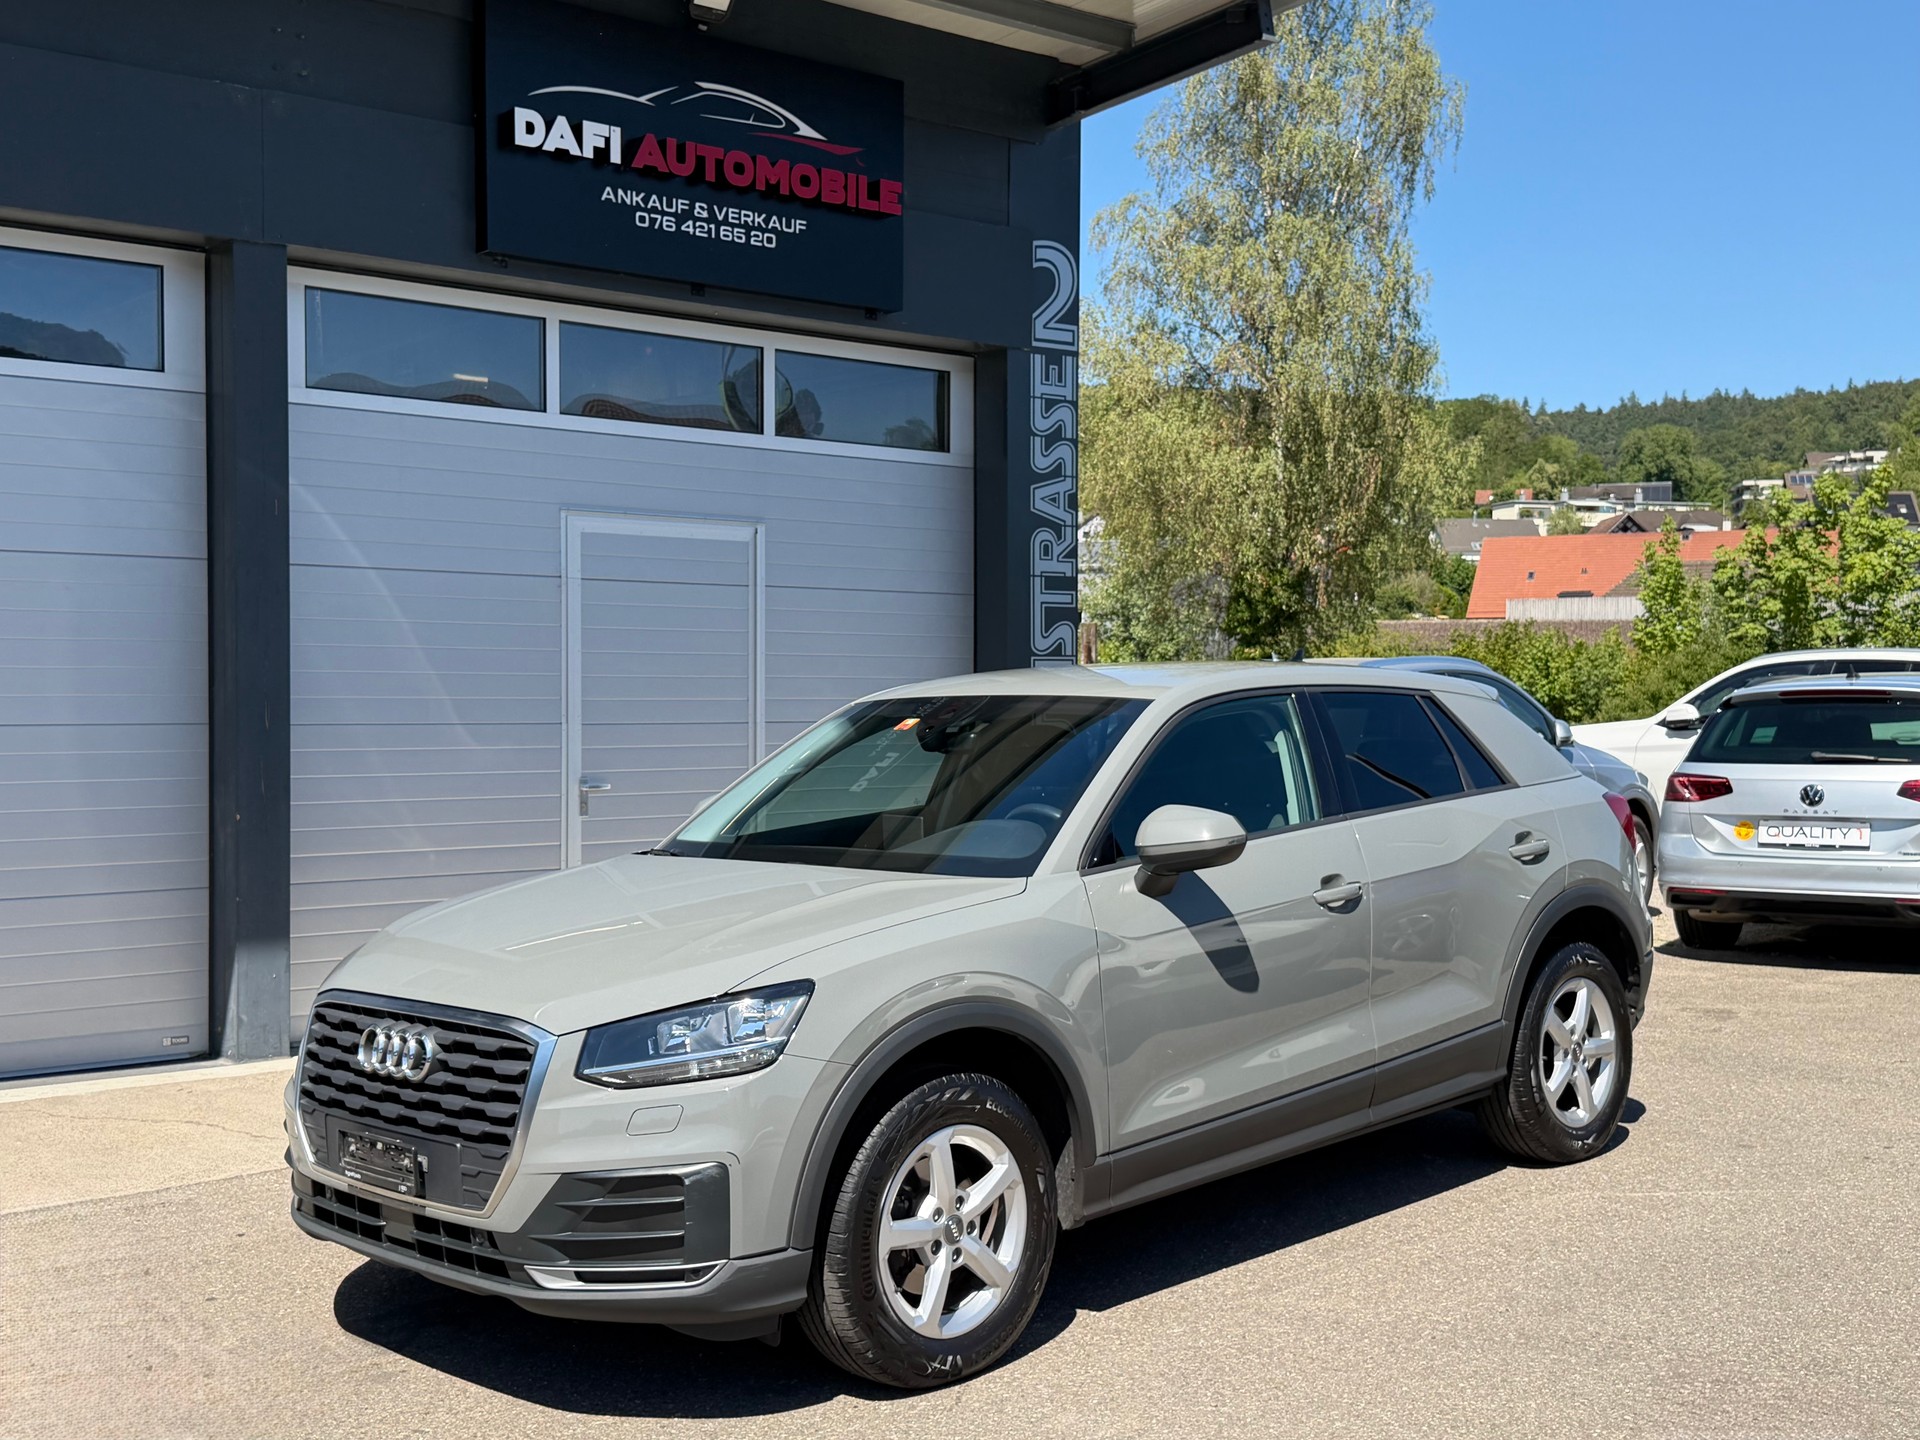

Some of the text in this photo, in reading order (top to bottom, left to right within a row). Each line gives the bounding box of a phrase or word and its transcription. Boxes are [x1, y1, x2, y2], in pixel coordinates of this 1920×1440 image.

[514, 106, 902, 215] DAFI AUTOMOBILE
[601, 186, 807, 234] ANKAUF & VERKAUF
[635, 212, 776, 248] 076 421 65 20
[1031, 239, 1078, 351] 2
